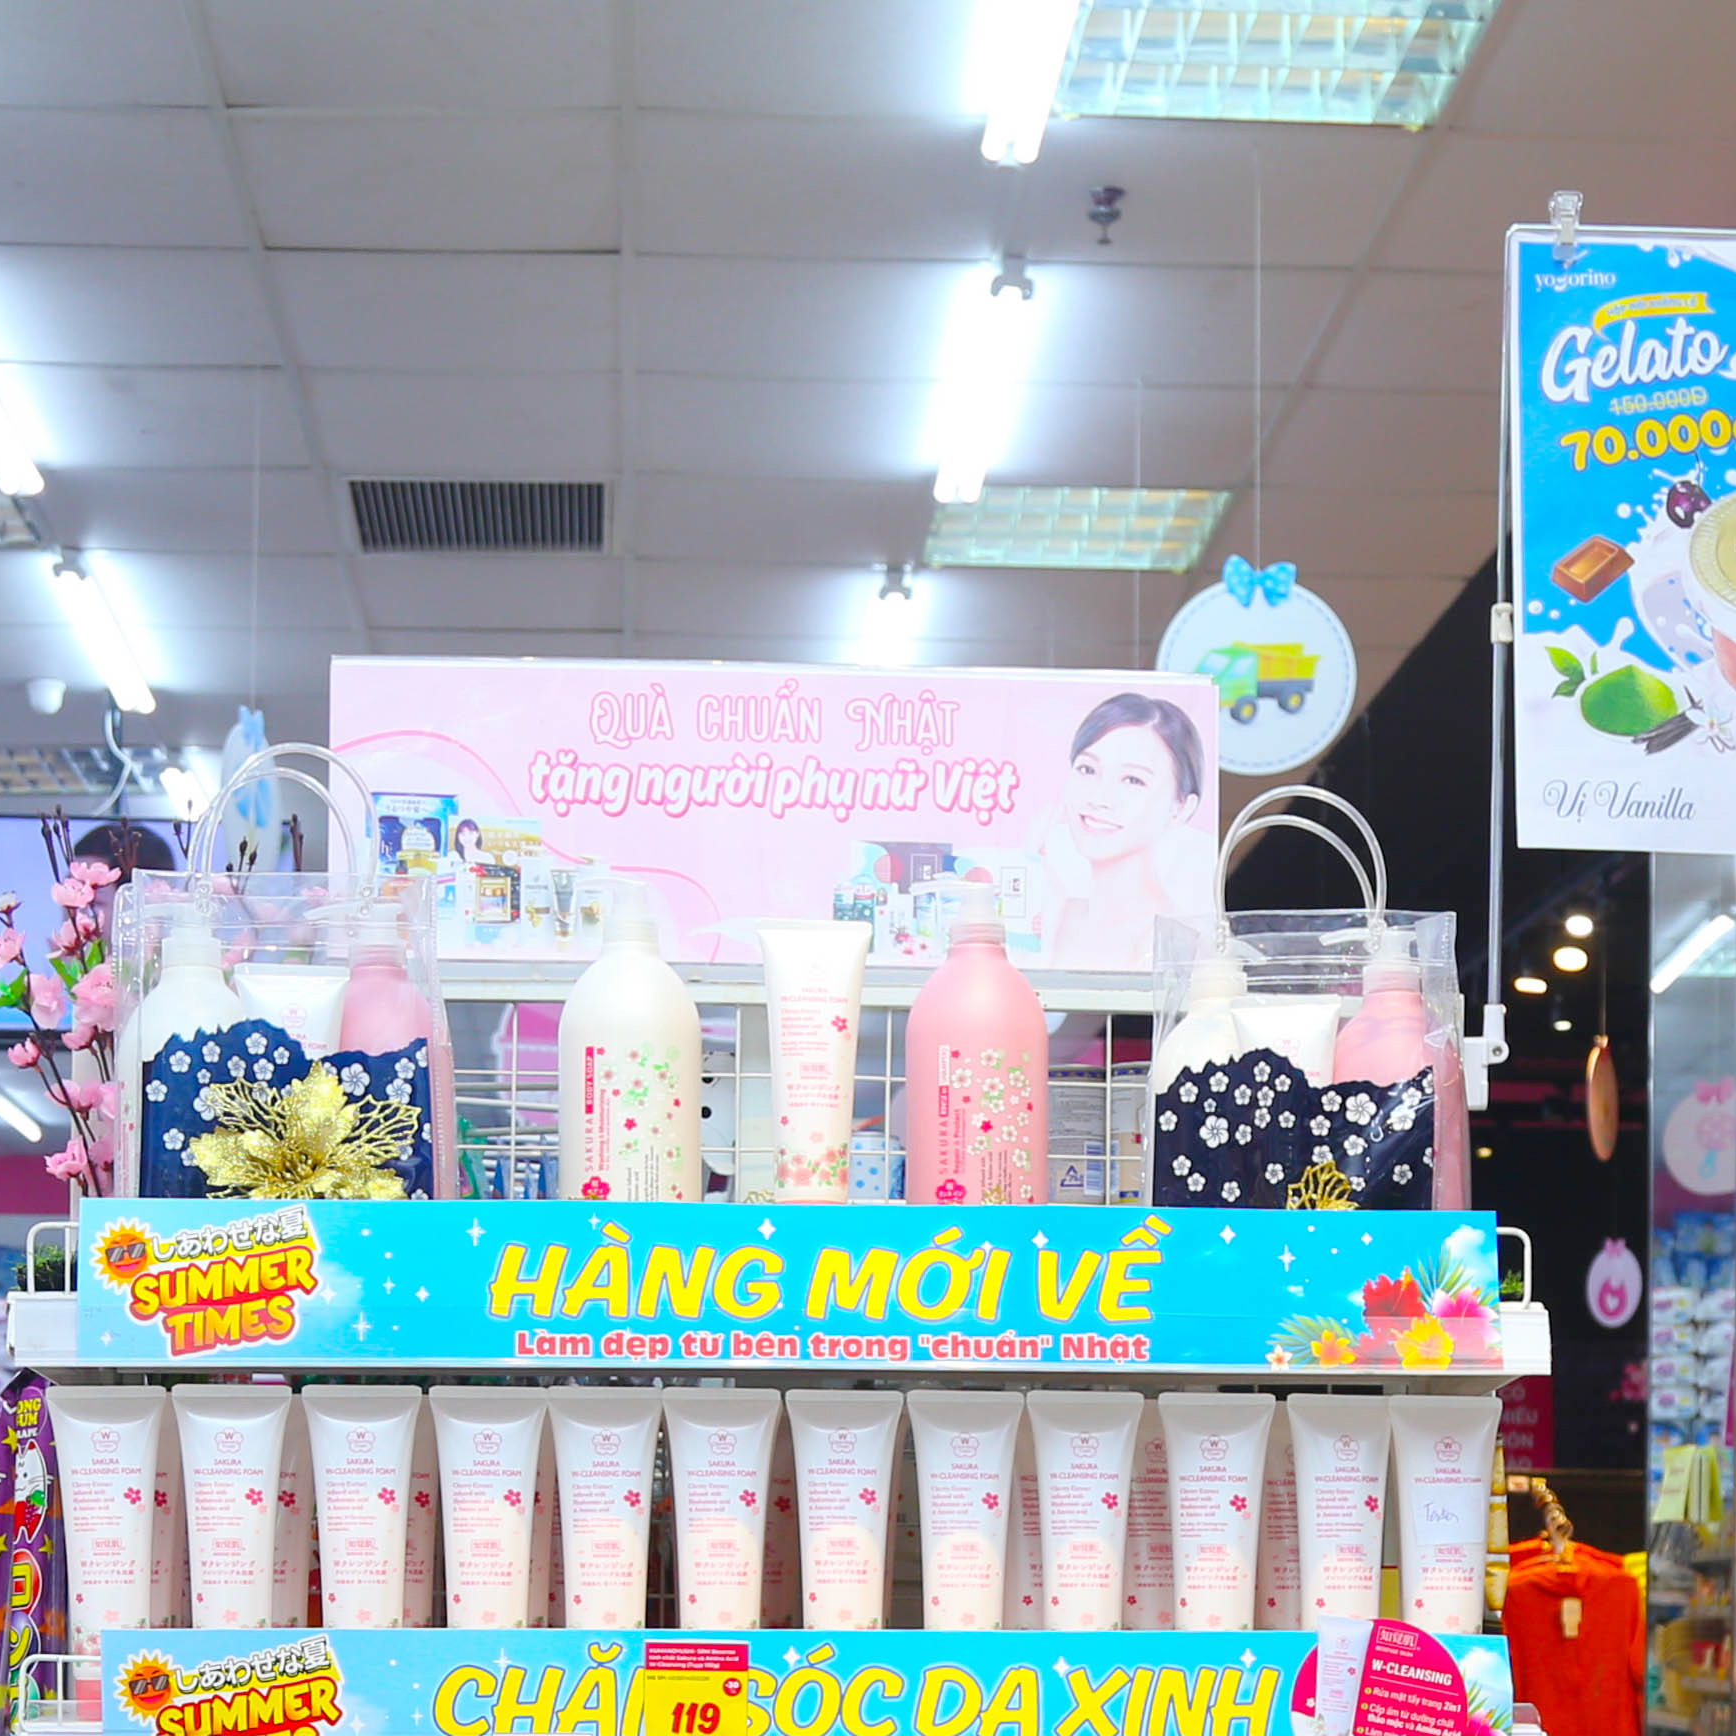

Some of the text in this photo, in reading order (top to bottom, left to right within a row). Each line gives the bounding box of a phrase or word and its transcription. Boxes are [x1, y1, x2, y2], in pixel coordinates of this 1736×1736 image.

[1534, 270, 1617, 292] yogorino
[1541, 318, 1729, 403] Gelato
[590, 678, 958, 754] QUÀ CHUẨN NHẬT
[530, 750, 1019, 824] tặng người phụ nữ Việt
[1593, 780, 1695, 822] Vanilla
[151, 1207, 307, 1262] しあわせな夏
[132, 1248, 317, 1316] SUMMER
[490, 1214, 1173, 1323] HÀNG MỚI VỀ
[167, 1295, 295, 1356] TIMES
[516, 1330, 592, 1358] Làm
[602, 1329, 671, 1363] đẹp
[683, 1330, 722, 1358] từ
[733, 1329, 799, 1358] bên
[810, 1335, 910, 1363] trong
[1062, 1334, 1151, 1364] Nhật
[175, 1634, 329, 1693] しあわせな夏
[1372, 1658, 1453, 1686] W-CLEANSING
[672, 1702, 721, 1735] 119
